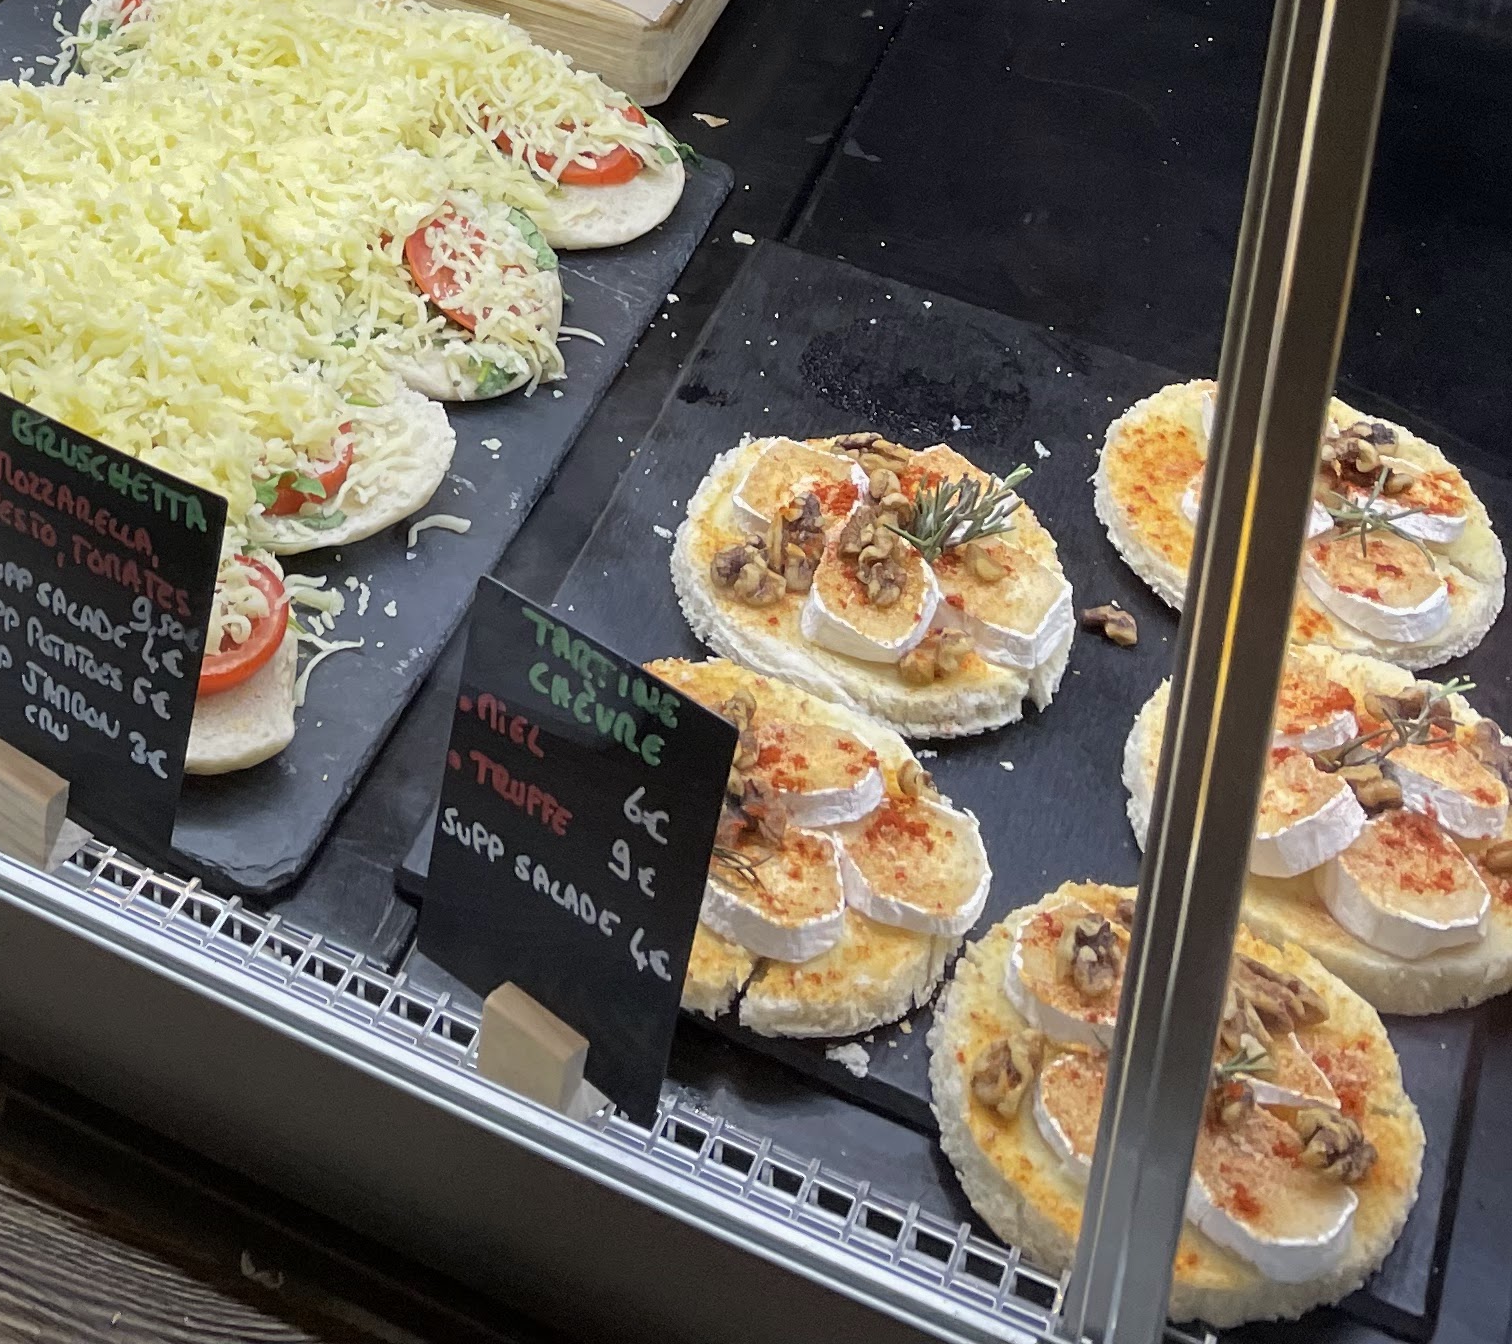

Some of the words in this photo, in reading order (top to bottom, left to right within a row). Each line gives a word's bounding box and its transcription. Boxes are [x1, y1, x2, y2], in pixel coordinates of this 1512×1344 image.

[12, 408, 208, 534] BRUSCHETTA
[36, 582, 132, 650] SALADE
[71, 533, 192, 618] TOMATES
[26, 615, 124, 693] POTATOES
[521, 605, 682, 730] TARTINE
[469, 749, 574, 837] TRUFFE
[623, 785, 670, 846] 6€
[441, 807, 506, 863] SUPP
[514, 854, 622, 937] SALADE
